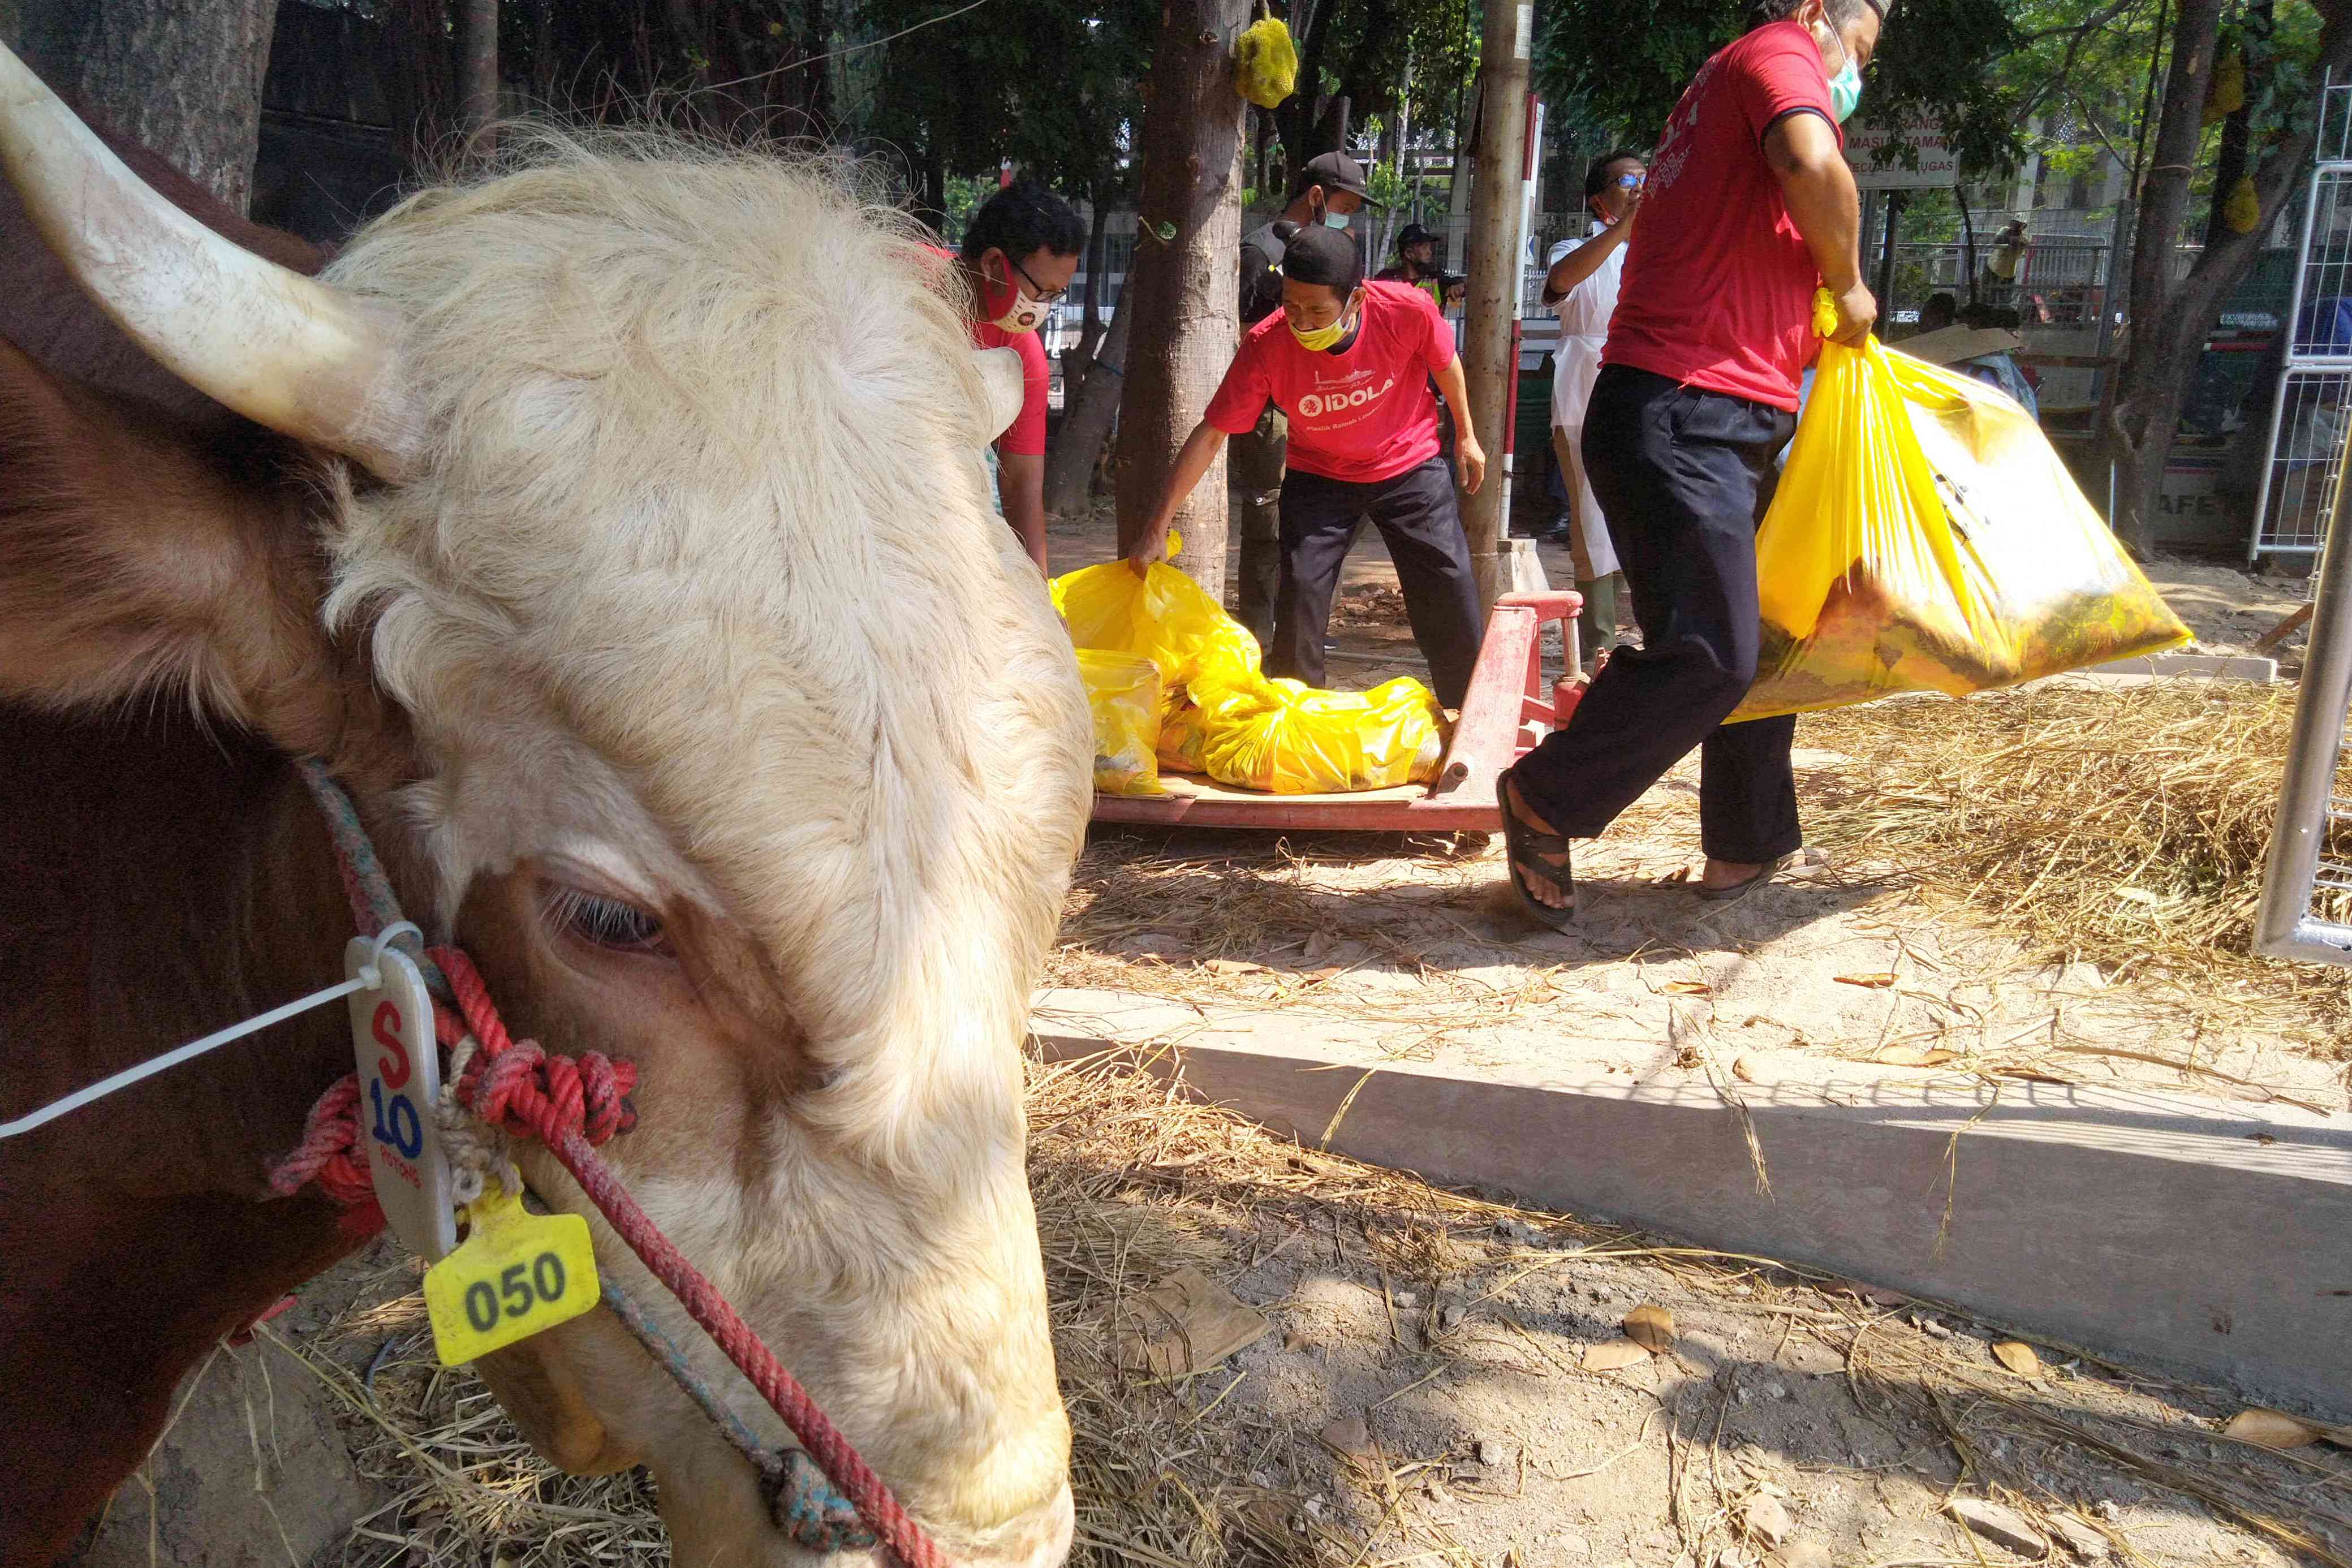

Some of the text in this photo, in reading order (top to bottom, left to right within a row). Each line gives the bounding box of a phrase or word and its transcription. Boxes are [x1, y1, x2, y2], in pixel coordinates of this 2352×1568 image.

[1864, 117, 1942, 131] DILRANG
[1849, 135, 1956, 149] MASU TAMAN
[1849, 162, 1895, 173] ECUALI
[1324, 378, 1394, 412] IDOLA
[371, 1000, 411, 1090] S
[370, 1077, 423, 1160] 10
[465, 1252, 566, 1333] 050
